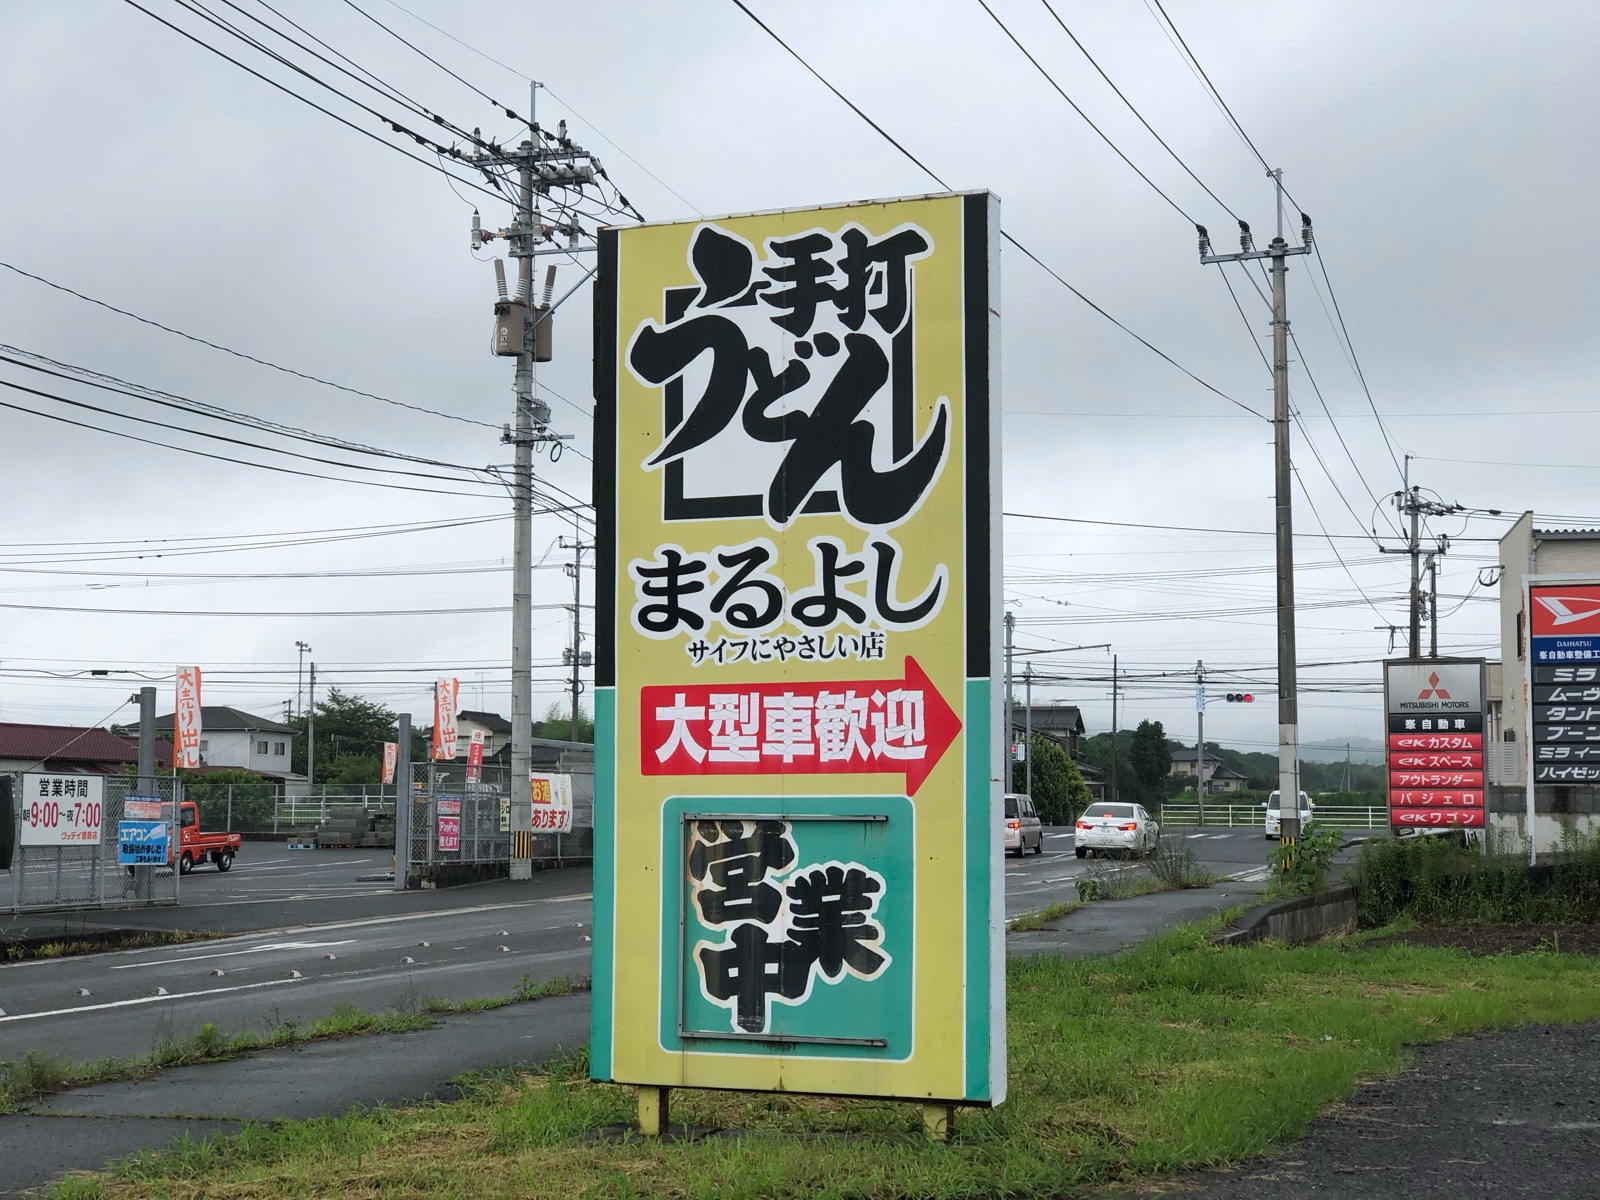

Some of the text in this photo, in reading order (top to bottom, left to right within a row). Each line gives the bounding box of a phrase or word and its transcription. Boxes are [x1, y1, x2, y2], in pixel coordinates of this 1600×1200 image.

[759, 228, 929, 338] 手打
[630, 227, 947, 525] うどん
[635, 541, 944, 633] まるよし
[688, 631, 885, 664] サイフにやさしい店
[1556, 640, 1593, 648] DAIHATSU
[1553, 667, 1598, 682] ミラ
[1547, 687, 1600, 702] ムーヴ
[1400, 701, 1470, 709] MITSUBISHI MOTORS
[180, 668, 199, 767] 大売り出し
[439, 679, 457, 759] 大売り出し
[1546, 706, 1600, 721] タント
[654, 688, 928, 765] 大型車歓迎
[1546, 726, 1600, 741] ブーン
[1399, 774, 1475, 786] アウトランダー
[1538, 766, 1600, 779] ハイゼッ
[39, 778, 89, 798] 営業時間
[1400, 792, 1475, 805] パジェロ
[120, 827, 151, 842] エアコン
[688, 820, 887, 1034] 営業中
